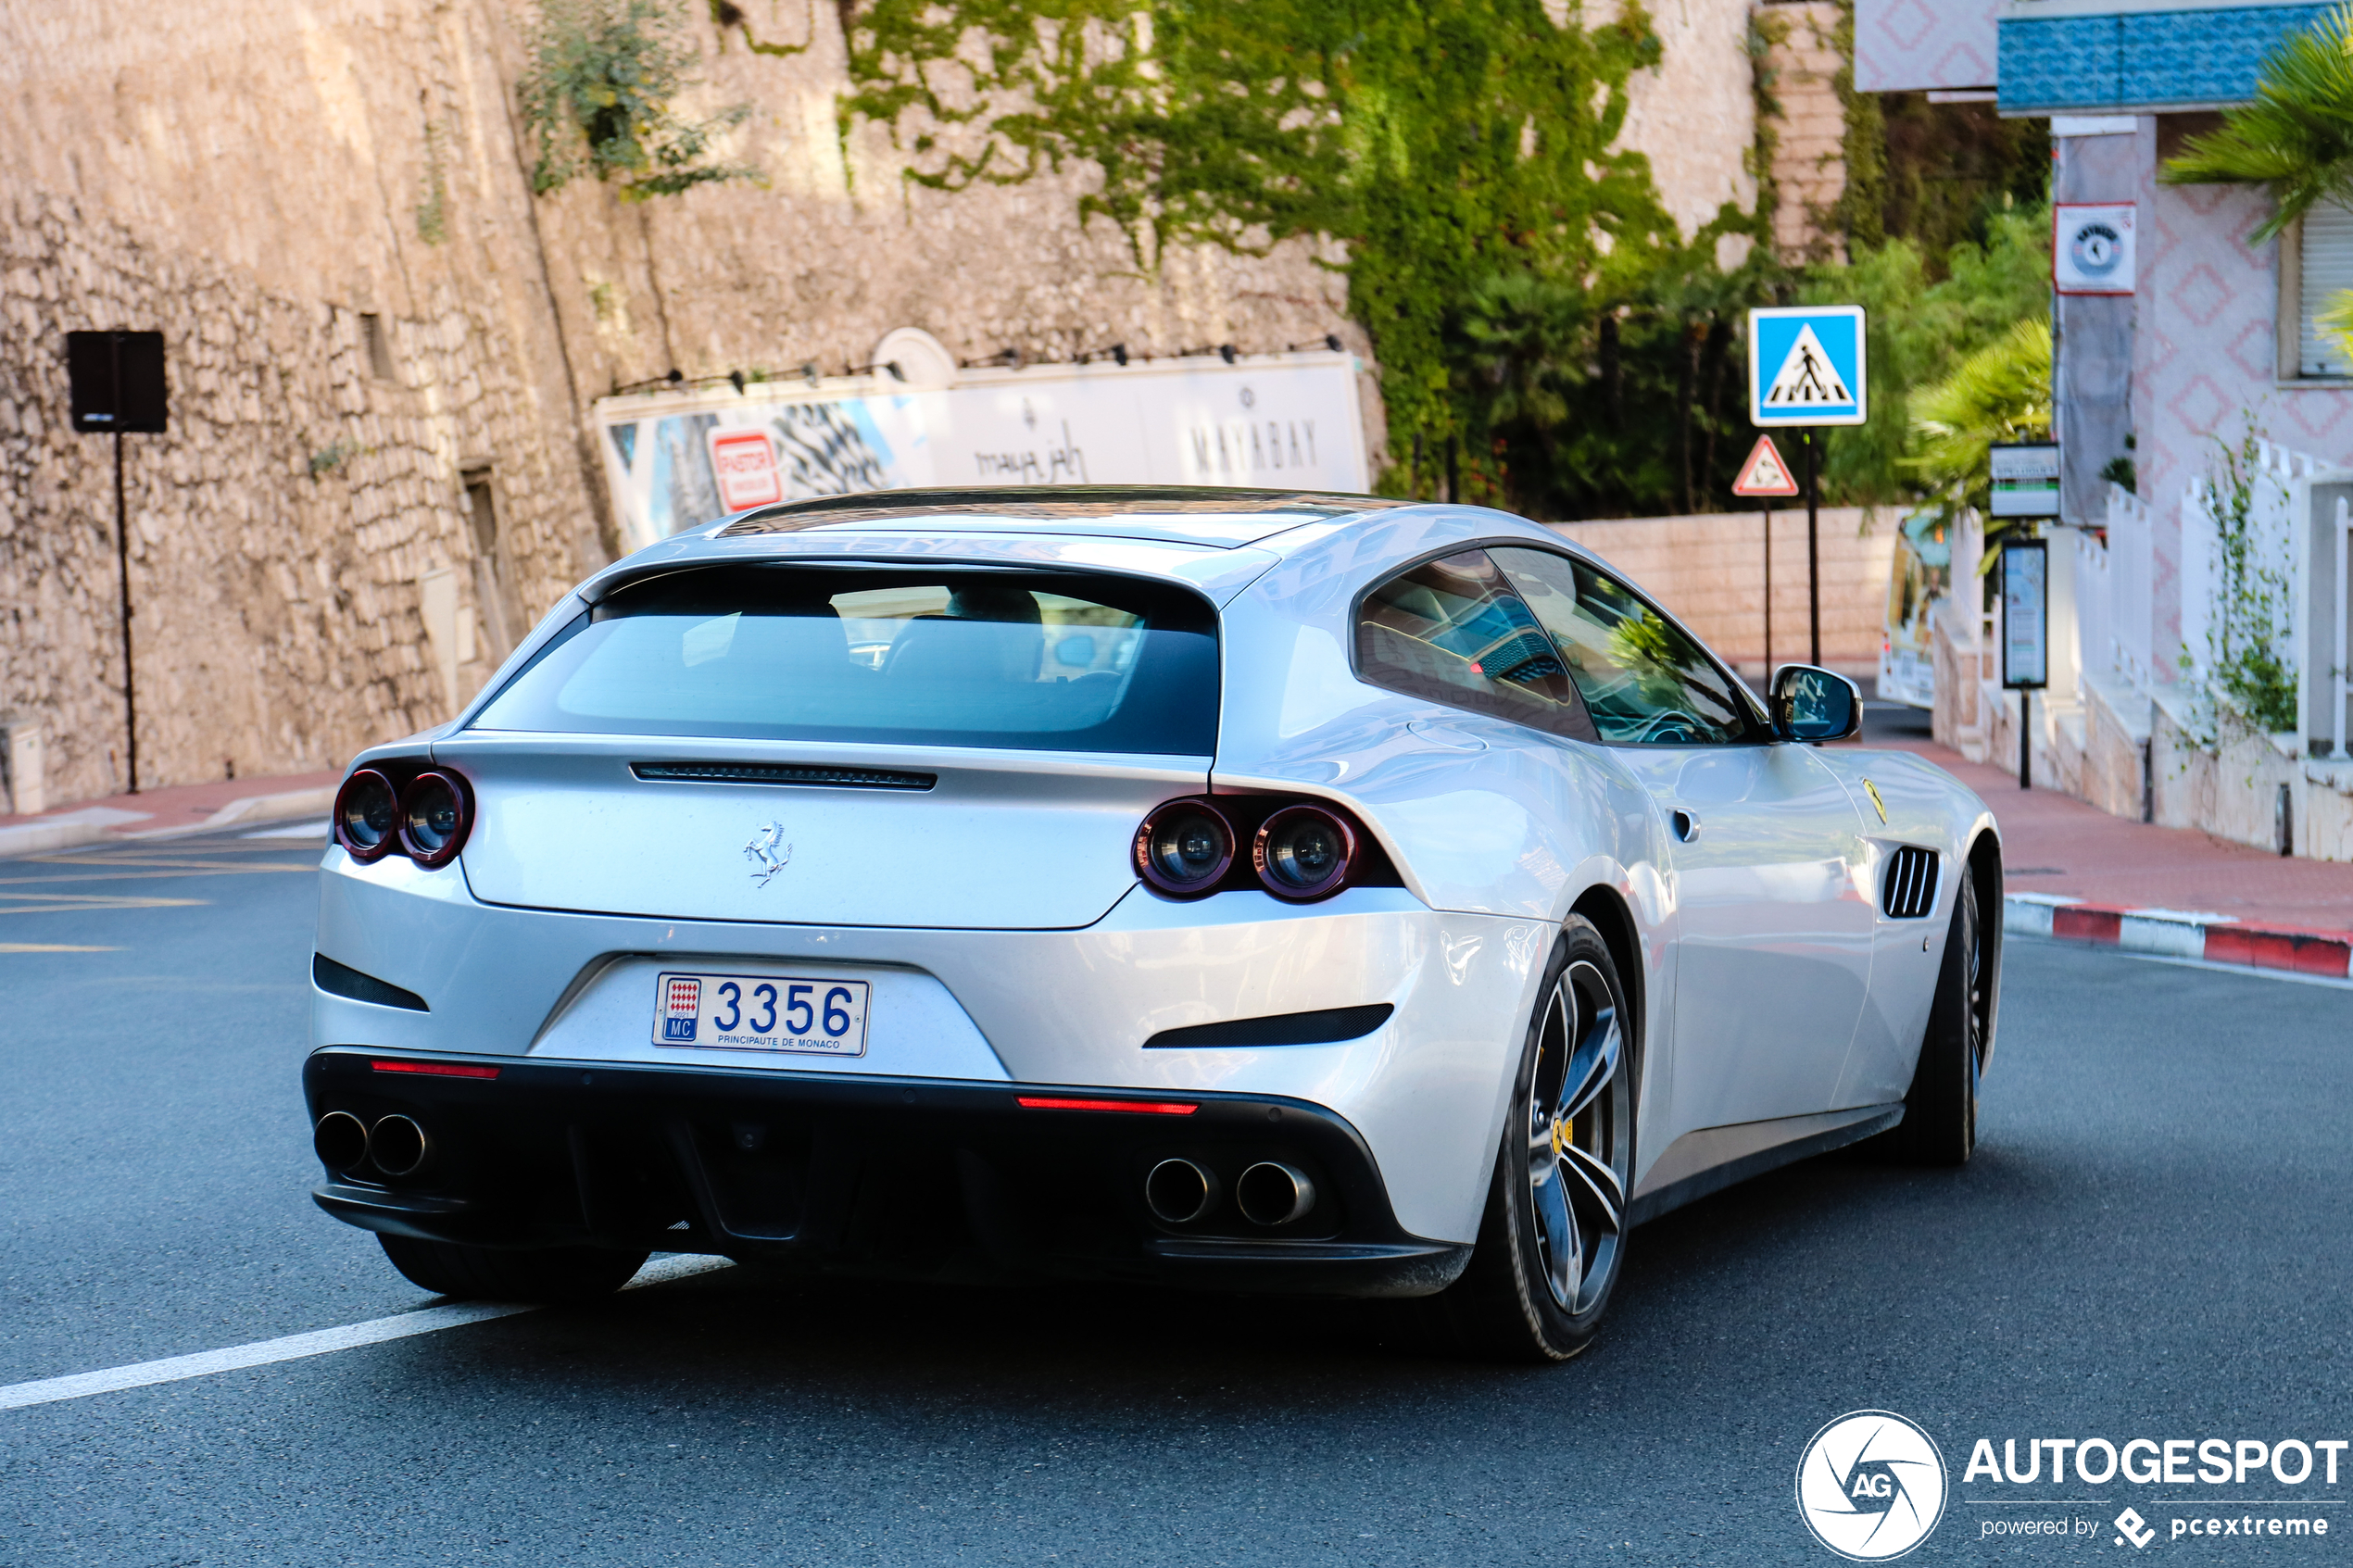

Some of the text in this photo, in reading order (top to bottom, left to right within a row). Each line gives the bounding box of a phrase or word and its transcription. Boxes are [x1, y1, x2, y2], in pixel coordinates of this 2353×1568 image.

[1189, 419, 1316, 473] MAYABAY
[714, 982, 853, 1037] 3356
[671, 1020, 691, 1036] MC
[718, 1035, 840, 1049] PRINCIPAUTE DE MONACO
